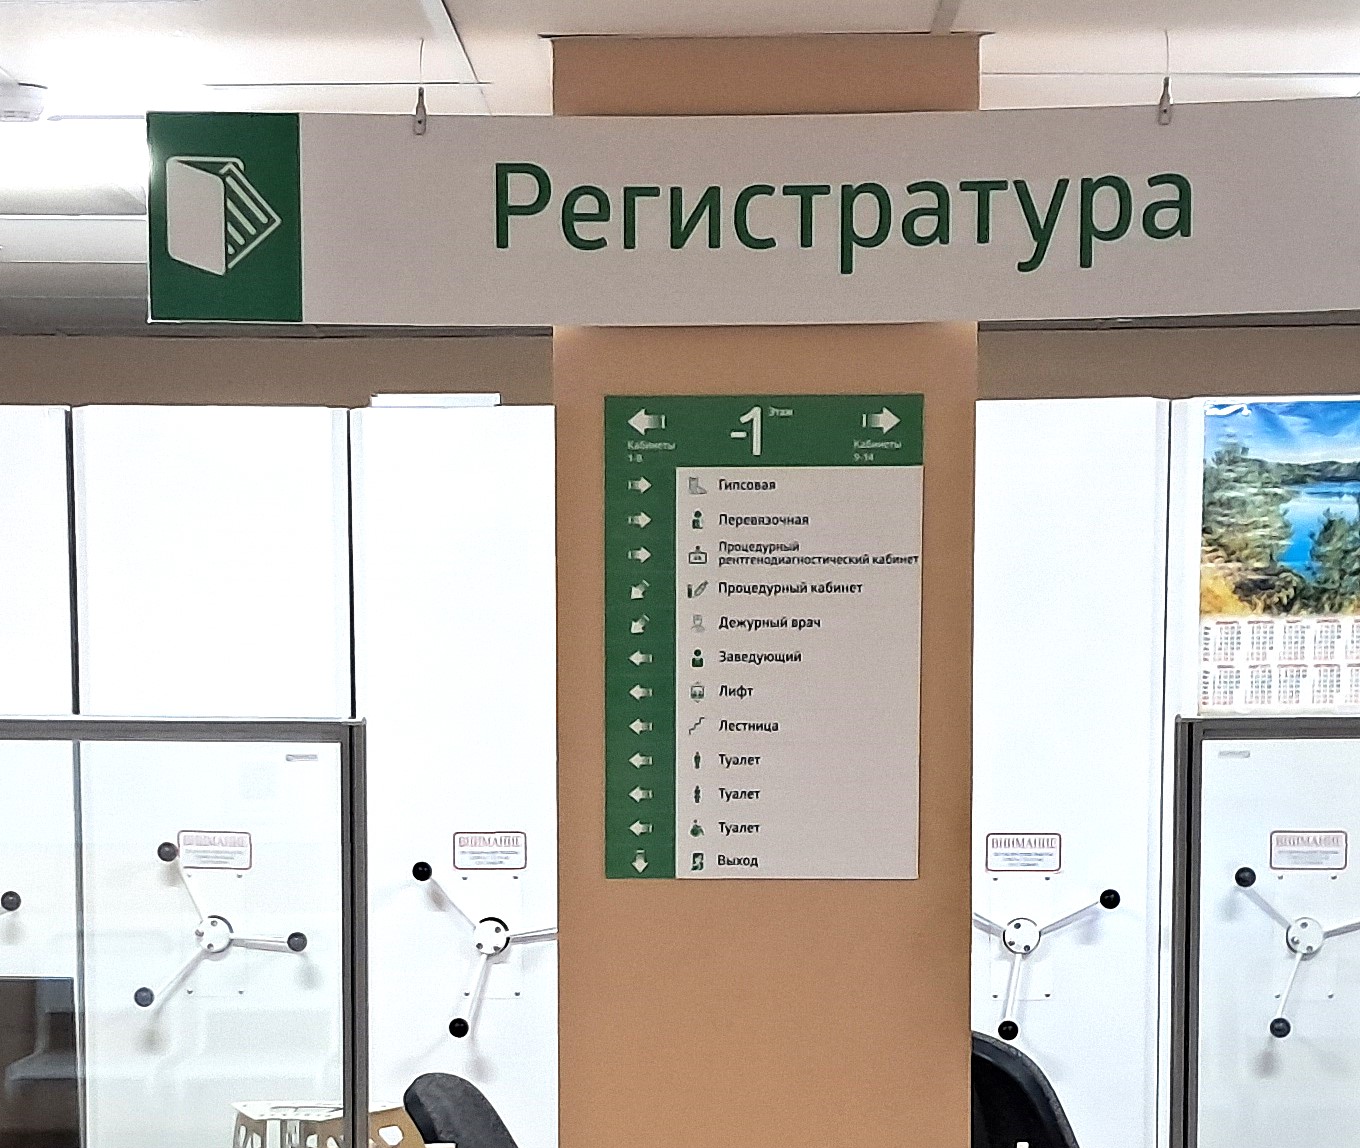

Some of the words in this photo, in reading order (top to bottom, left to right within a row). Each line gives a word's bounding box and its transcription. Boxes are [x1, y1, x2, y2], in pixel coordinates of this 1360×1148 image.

[493, 161, 1195, 274] Регистратура
[730, 406, 762, 456] -1
[627, 439, 676, 451] Кабинеты
[853, 438, 902, 450] Кабинеты
[718, 478, 776, 492] Гипсовая
[718, 513, 809, 528] Перевязочная
[718, 540, 799, 554] Процедурный
[718, 553, 870, 567] рентгенодиагностический
[872, 554, 919, 566] кабинет
[718, 580, 808, 597] Процедурный
[810, 582, 863, 595] кабинет
[718, 614, 788, 632] Дежурный
[791, 618, 821, 632] врач
[718, 650, 802, 666] Заведующий
[718, 685, 754, 700] Лифт
[718, 719, 779, 734] Лестница
[718, 754, 761, 769] Туалет
[718, 788, 760, 803] Туалет
[718, 822, 760, 837] Туалет
[717, 855, 759, 870] Выход
